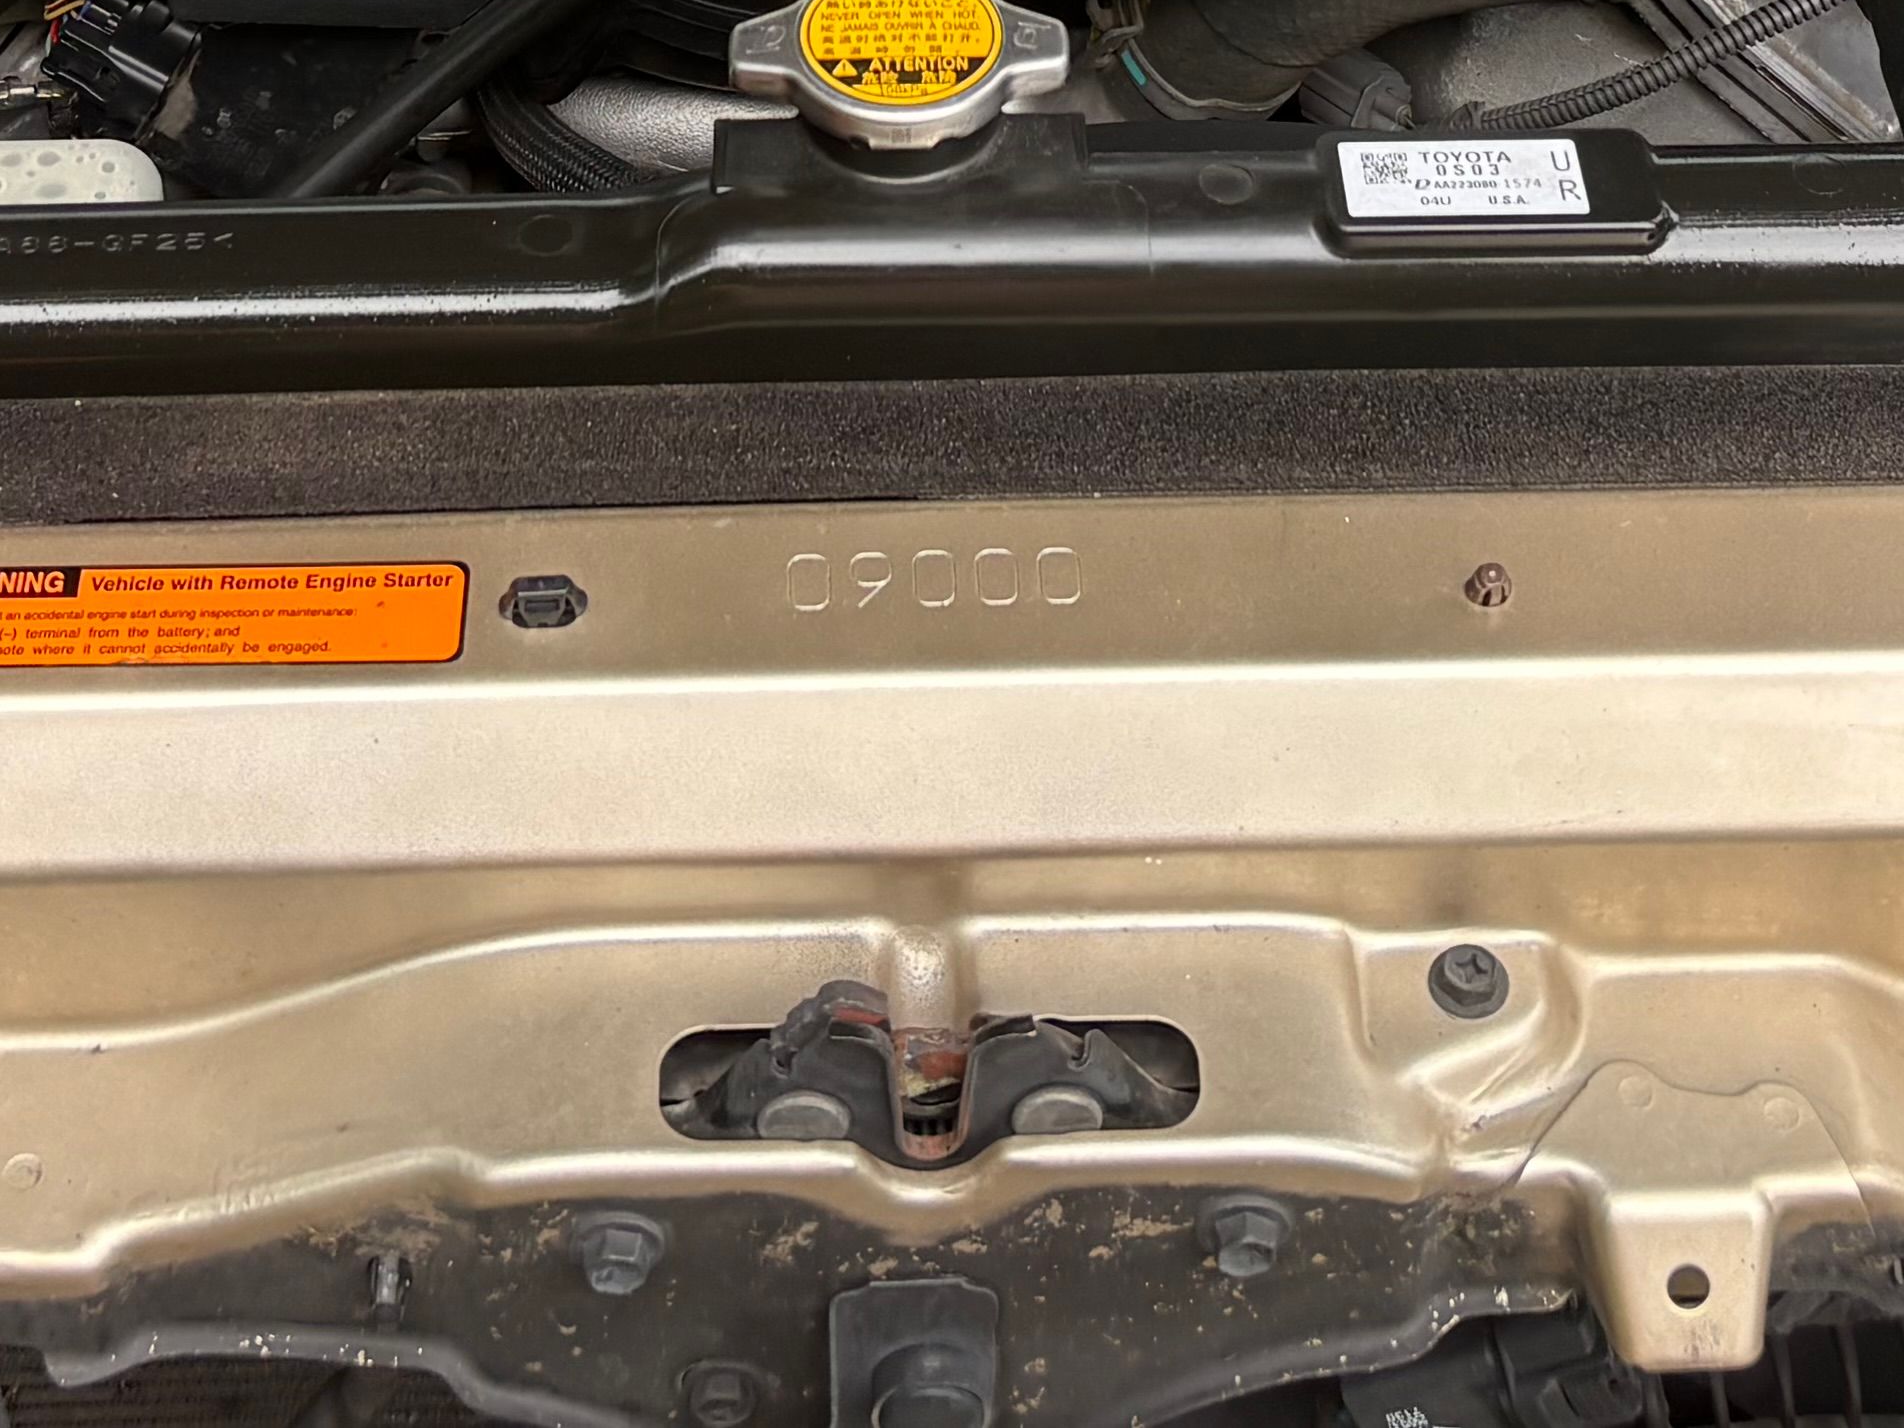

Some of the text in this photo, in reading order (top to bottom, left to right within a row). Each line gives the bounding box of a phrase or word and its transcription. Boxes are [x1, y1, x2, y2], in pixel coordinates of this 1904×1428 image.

[821, 11, 859, 21] NEVER
[868, 10, 900, 20] OPEN
[910, 9, 944, 20] WHEN
[869, 56, 969, 72] ATTENTION
[1418, 151, 1512, 164] TOYOTA
[1550, 149, 1571, 172] U
[1558, 179, 1582, 201] R
[92, 576, 164, 591] Vehicle
[171, 575, 213, 591] with
[220, 575, 299, 591] Remote
[306, 574, 377, 592] Engine
[384, 572, 454, 588] Starter
[787, 546, 1083, 612] 09000
[5, 611, 21, 621] an
[24, 609, 84, 621] accidental
[87, 610, 127, 623] engine
[130, 609, 156, 620] start
[159, 608, 196, 621] during
[200, 607, 259, 620] inspection
[262, 609, 275, 618] or
[26, 627, 81, 640] terminal
[88, 627, 119, 639] from
[128, 626, 149, 638] the
[214, 625, 240, 637] and
[33, 643, 75, 656] where
[83, 643, 91, 655] it
[99, 643, 146, 655] cannot
[154, 642, 234, 657] accidentally
[243, 642, 259, 654] be
[268, 641, 332, 655] engaged.
